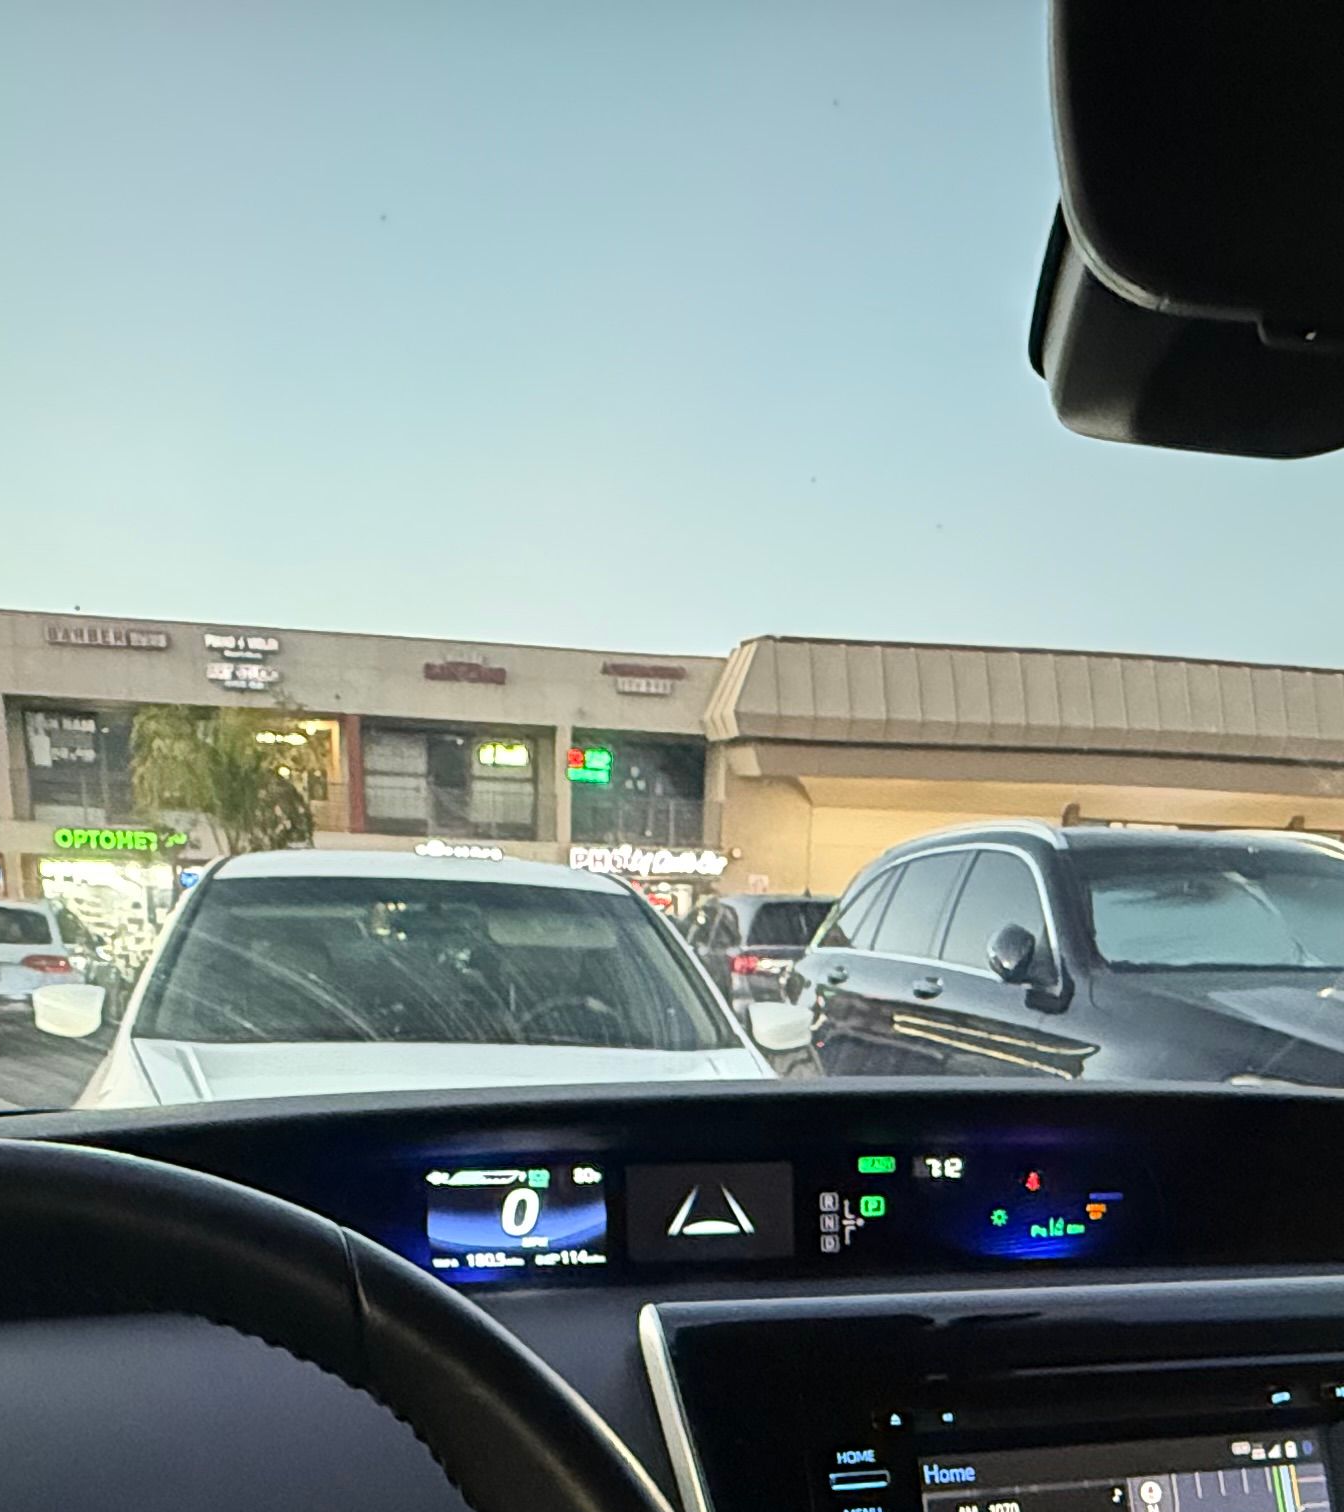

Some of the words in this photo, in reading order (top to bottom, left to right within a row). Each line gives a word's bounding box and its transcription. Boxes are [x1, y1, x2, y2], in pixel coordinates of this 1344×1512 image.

[502, 1188, 539, 1236] 0
[836, 1449, 876, 1464] HOME
[923, 1464, 976, 1484] Home
